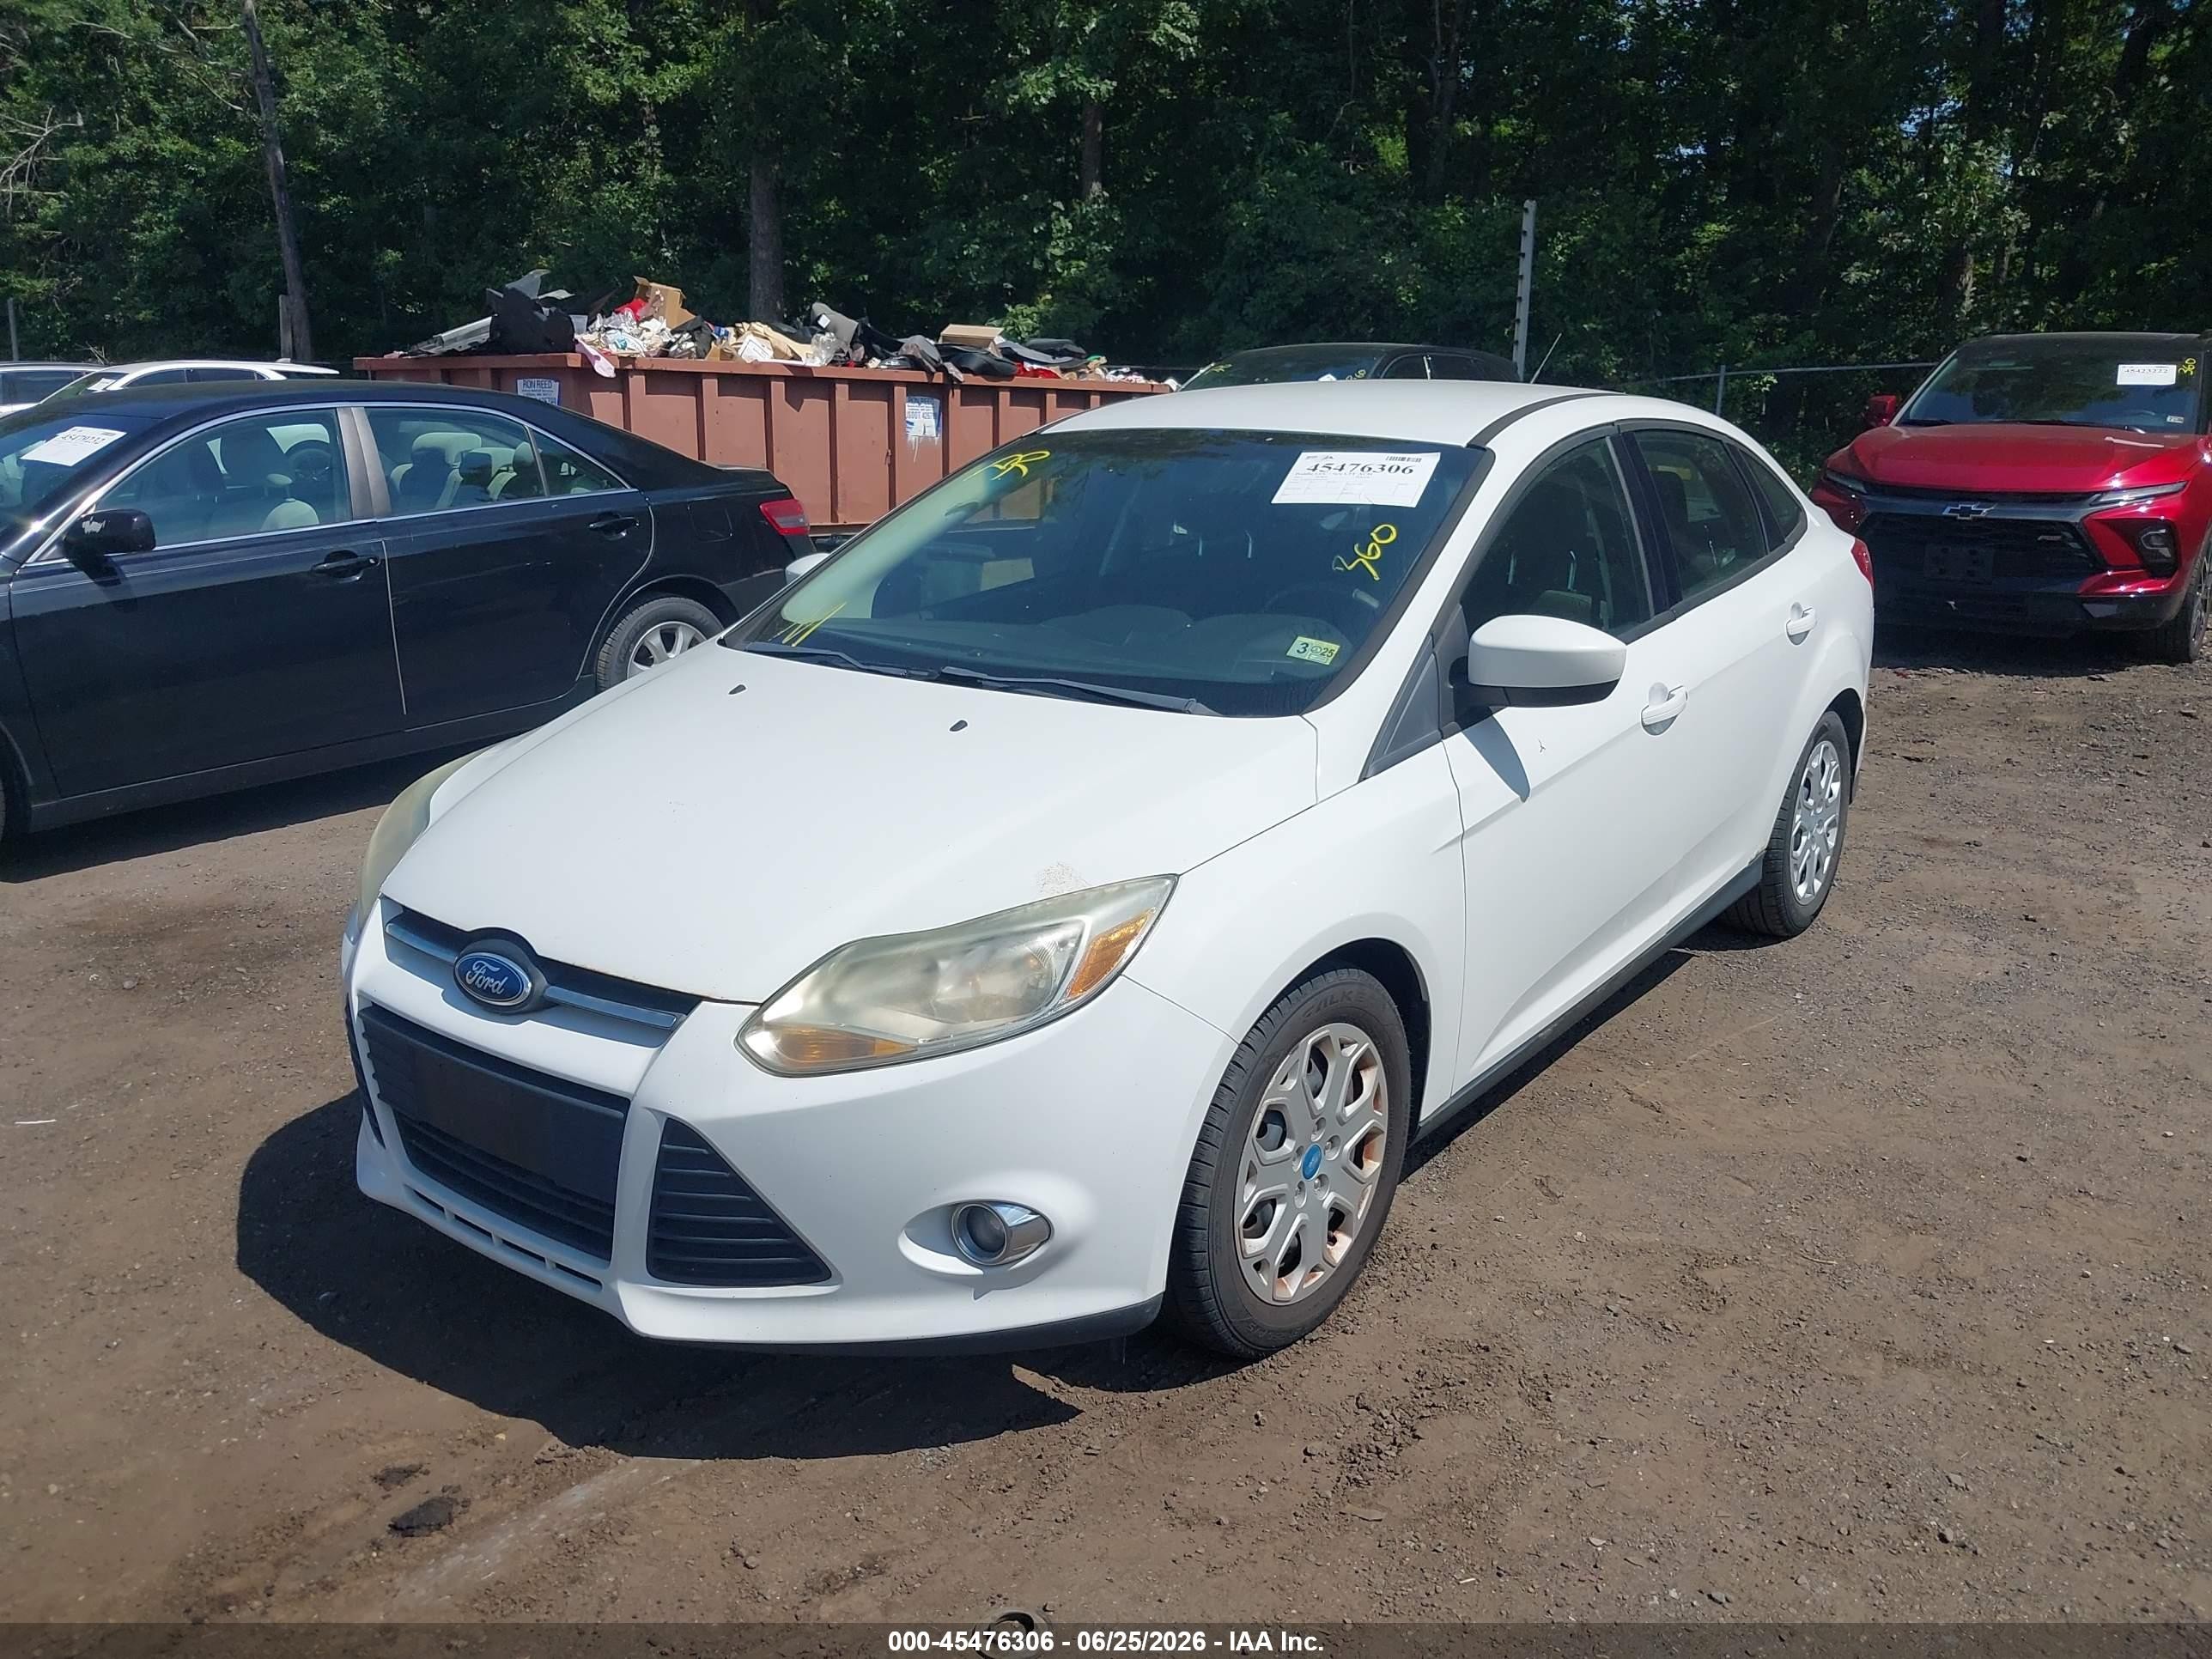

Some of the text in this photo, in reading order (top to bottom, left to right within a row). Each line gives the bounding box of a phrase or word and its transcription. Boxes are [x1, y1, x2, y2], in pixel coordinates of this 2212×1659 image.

[522, 380, 553, 389] RON REED
[1306, 463, 1416, 475] 45476306
[1332, 524, 1397, 581] 360
[1297, 642, 1336, 658] 3 25
[465, 960, 508, 995] Ford
